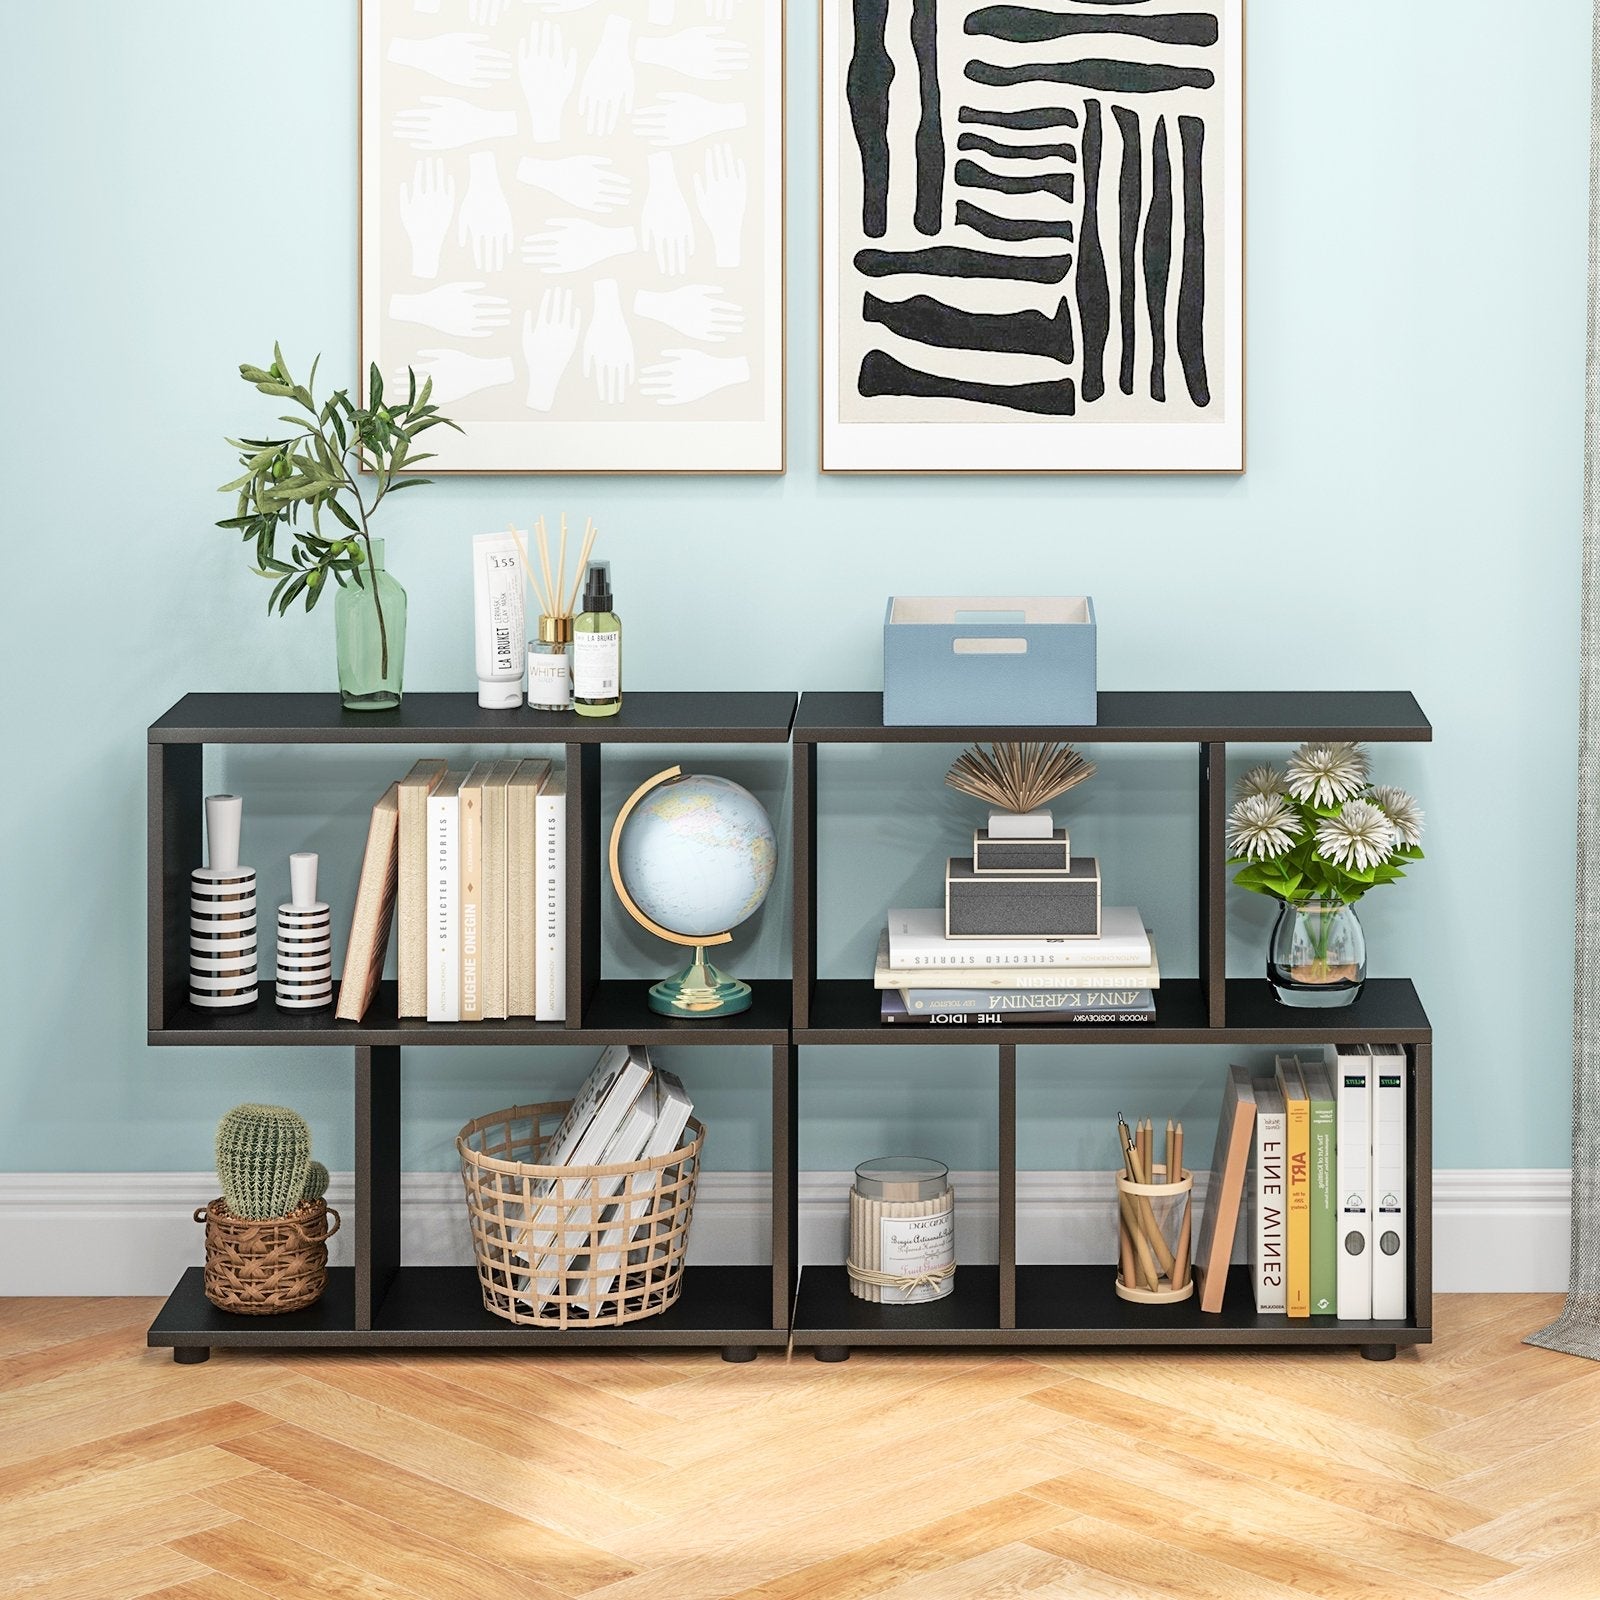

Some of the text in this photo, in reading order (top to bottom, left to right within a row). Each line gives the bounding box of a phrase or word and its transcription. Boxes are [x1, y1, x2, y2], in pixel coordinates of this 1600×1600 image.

[494, 557, 515, 568] 155
[496, 627, 511, 655] BRUKET
[596, 634, 617, 642] BRUKET
[530, 666, 566, 678] WHITE
[548, 818, 556, 938] SELECTED STORIES
[464, 904, 476, 1012] EUGENE ONEGIN
[914, 954, 1055, 965] SELECTED STORIES
[1016, 976, 1147, 988] EUGENE ONEGIN
[929, 1000, 962, 1008] TOLSTOY
[988, 992, 1140, 1009] ANNA KARENINA
[929, 1014, 1002, 1024] THE IDIOT
